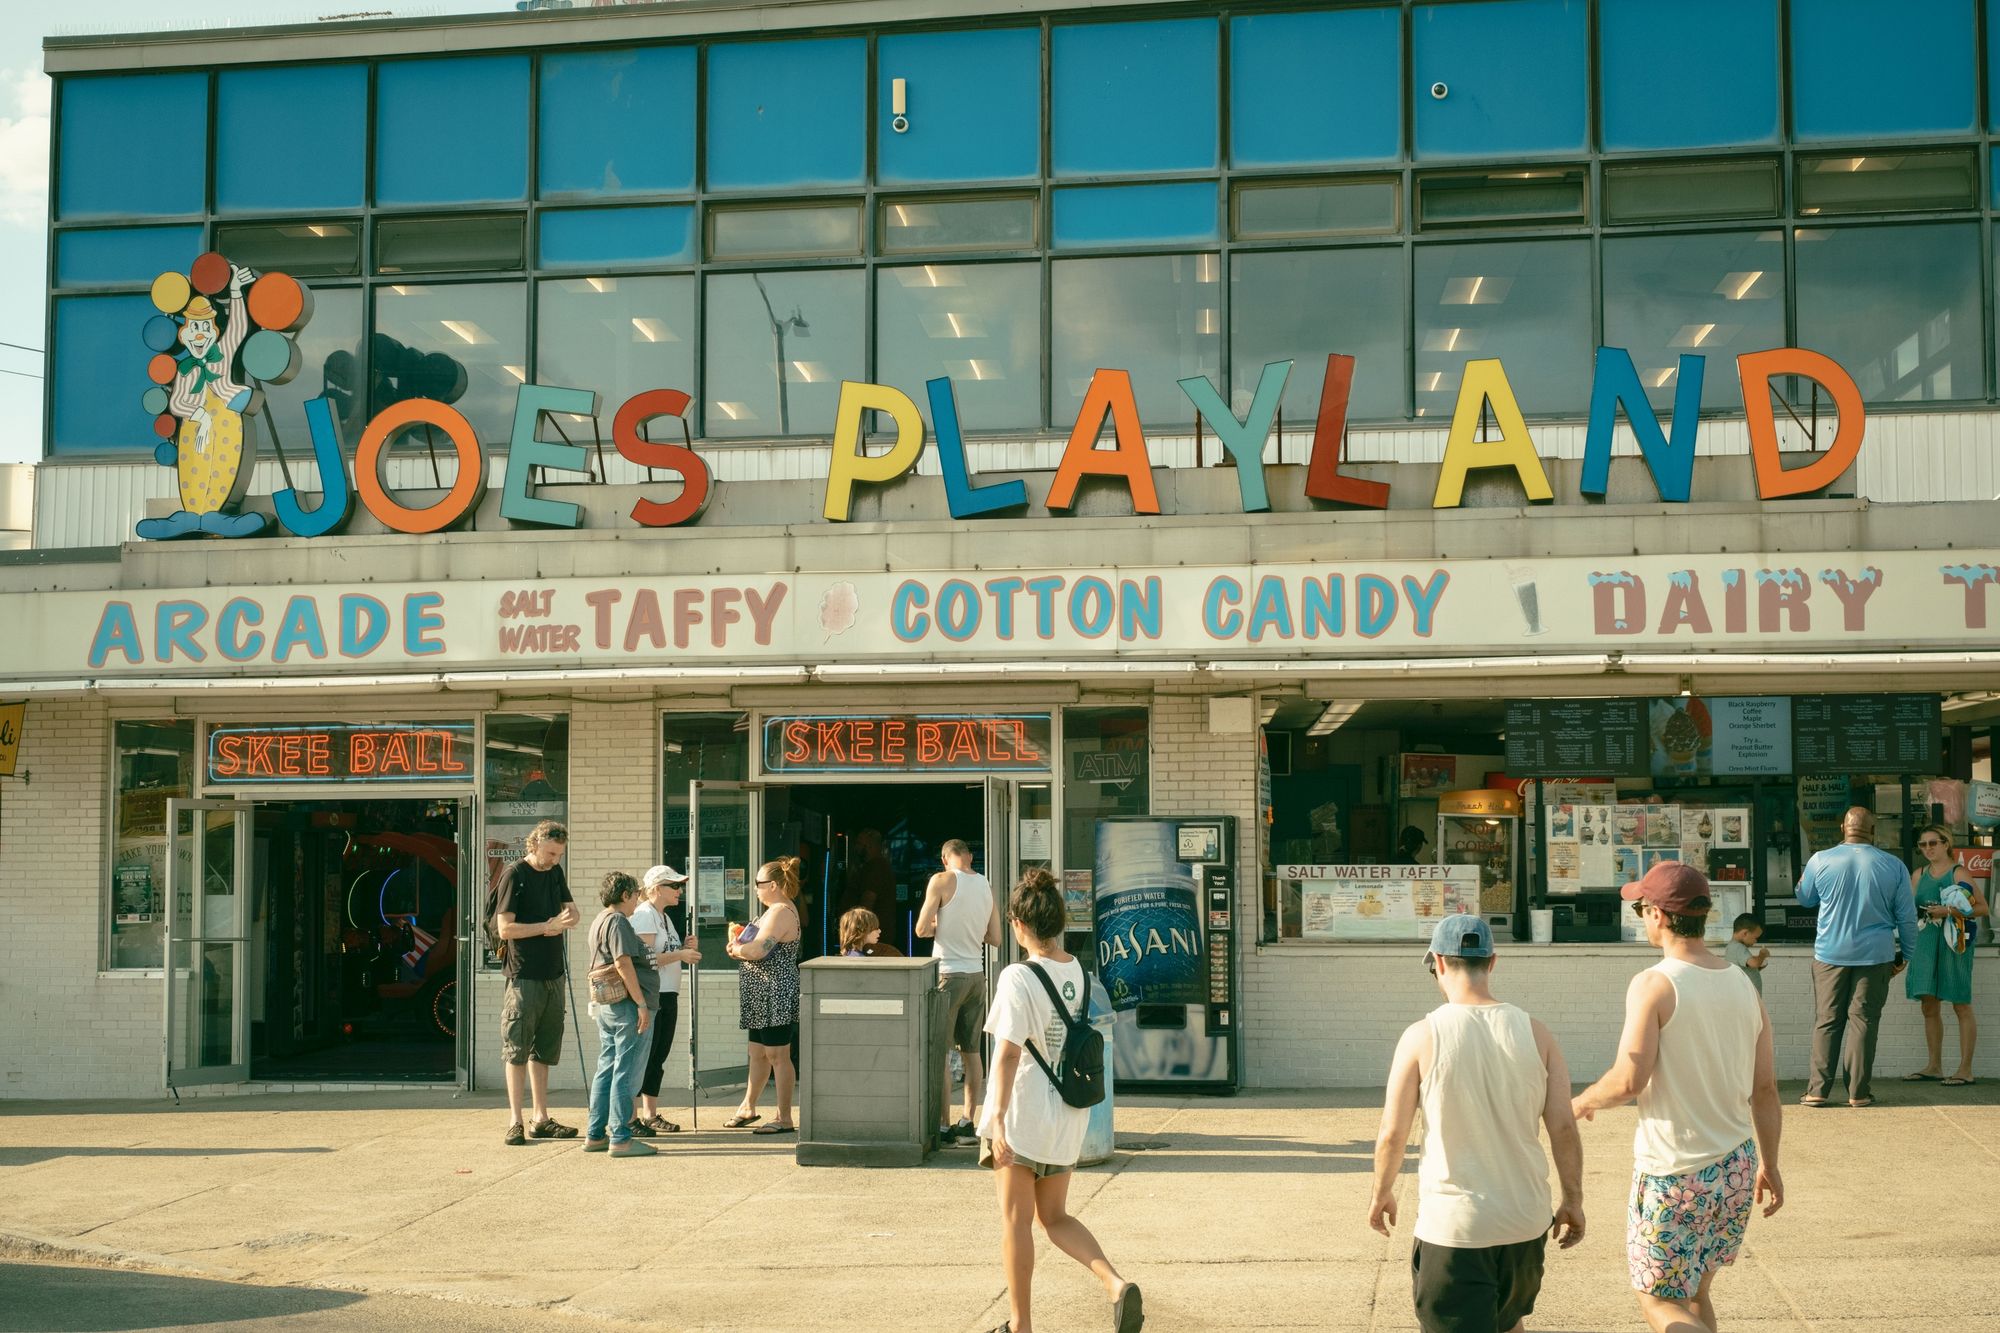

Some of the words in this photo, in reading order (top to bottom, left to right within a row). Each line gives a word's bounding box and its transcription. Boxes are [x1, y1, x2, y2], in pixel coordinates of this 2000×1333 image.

[272, 383, 713, 537] JOES
[824, 346, 1866, 522] PLAYLAND
[498, 589, 556, 619] SALT
[890, 575, 1163, 643] COTTON
[1202, 569, 1450, 643] CANDY
[1587, 566, 1883, 635] DAIRY
[87, 591, 447, 669] ARCADE
[585, 581, 788, 652] TAFFY
[499, 624, 581, 654] WATER
[1745, 701, 1776, 709] Raspberry
[217, 734, 330, 776] SKEE
[349, 731, 464, 774] BALL
[785, 720, 905, 763] SKEE
[916, 720, 1039, 763] BALL
[1077, 752, 1141, 778] ATM
[1802, 783, 1820, 792] HALF
[120, 846, 142, 862] TAKE
[489, 848, 516, 857] CREATE
[1287, 865, 1327, 879] SALT
[1335, 865, 1391, 879] WATER
[1400, 865, 1452, 879] TAFFY
[1114, 894, 1142, 906] PURIFIED
[1143, 891, 1166, 901] WATER
[1099, 921, 1198, 968] DASANI
